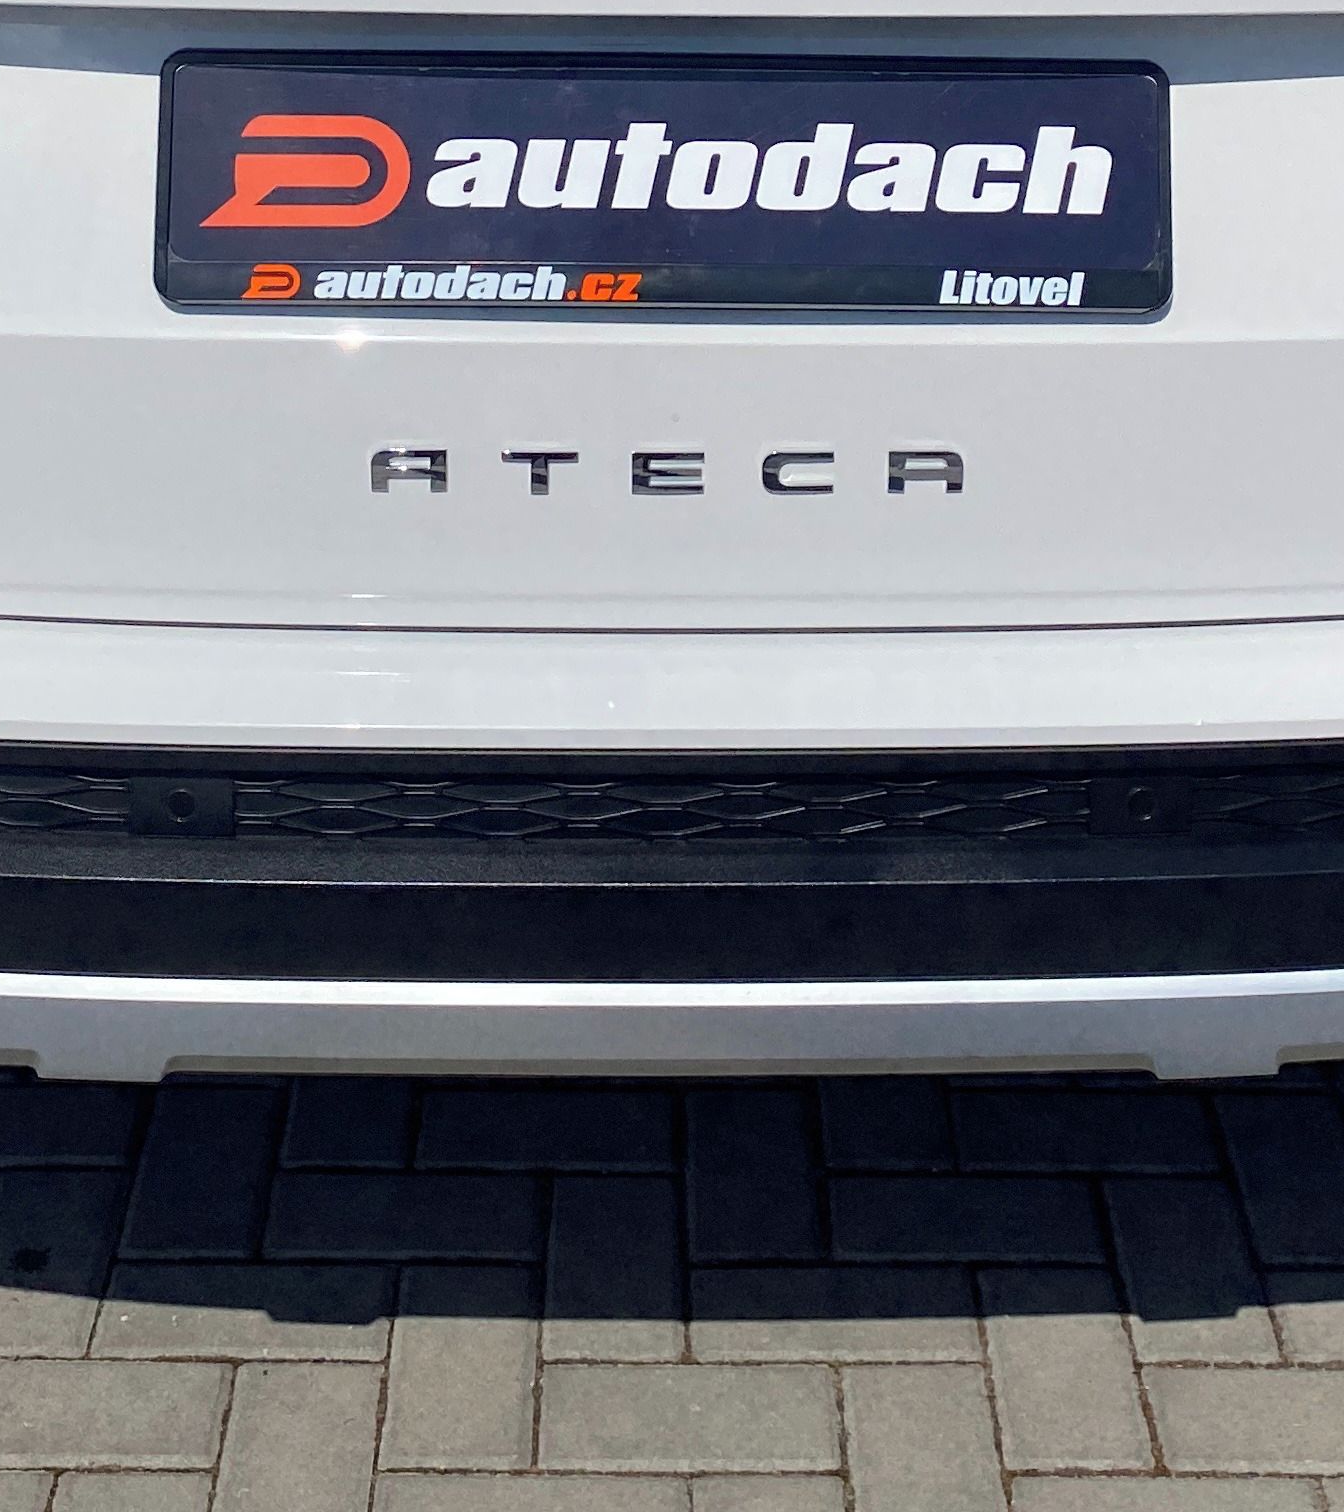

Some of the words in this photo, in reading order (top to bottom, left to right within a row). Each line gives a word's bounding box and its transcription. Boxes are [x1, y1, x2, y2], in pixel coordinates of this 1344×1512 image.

[426, 122, 1113, 215] autodach
[314, 264, 641, 303] autodach.cz
[939, 269, 1084, 306] Litovel
[370, 449, 964, 496] ATECA
